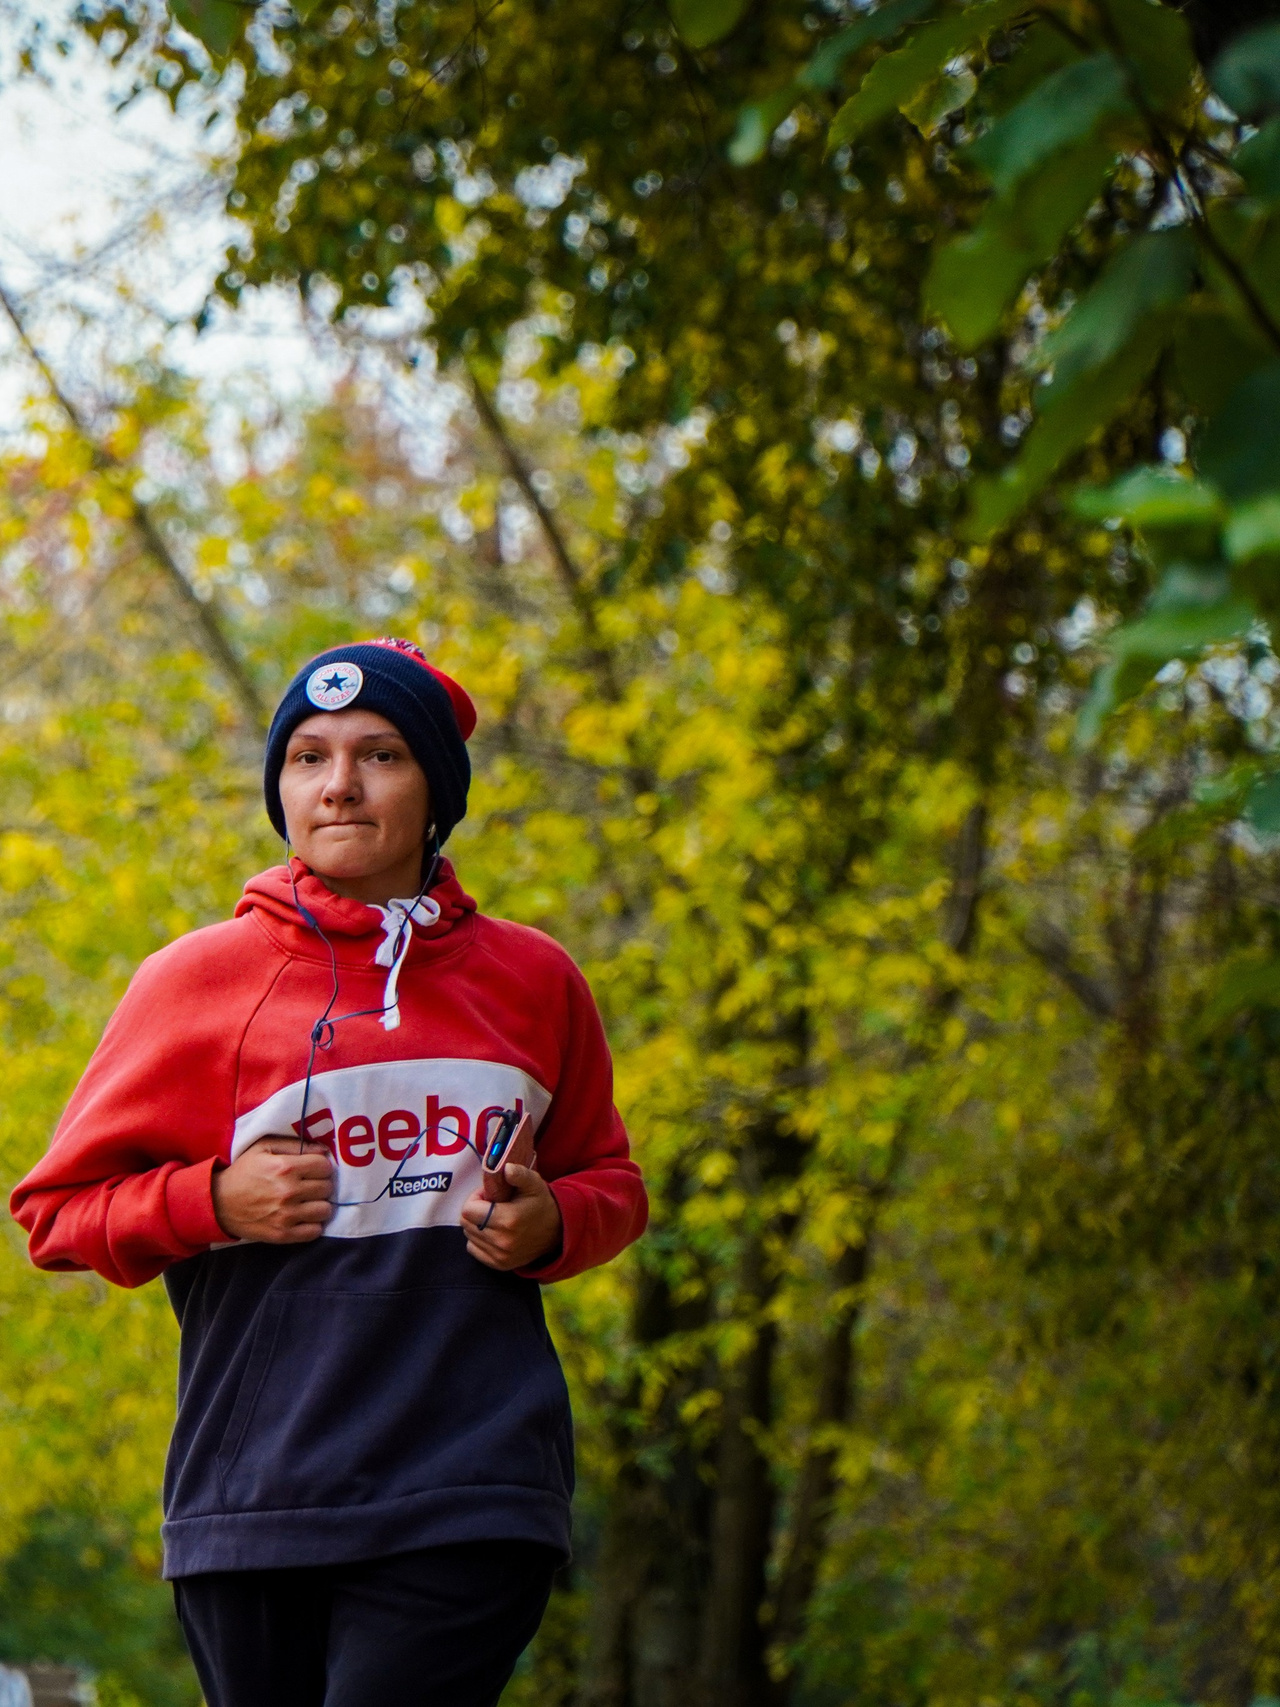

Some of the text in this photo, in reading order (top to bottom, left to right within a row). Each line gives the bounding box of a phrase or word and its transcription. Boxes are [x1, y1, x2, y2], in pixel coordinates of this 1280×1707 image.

[316, 689, 352, 703] ALL STAR
[291, 1095, 524, 1168] Reebo
[392, 1173, 448, 1194] Reebok
